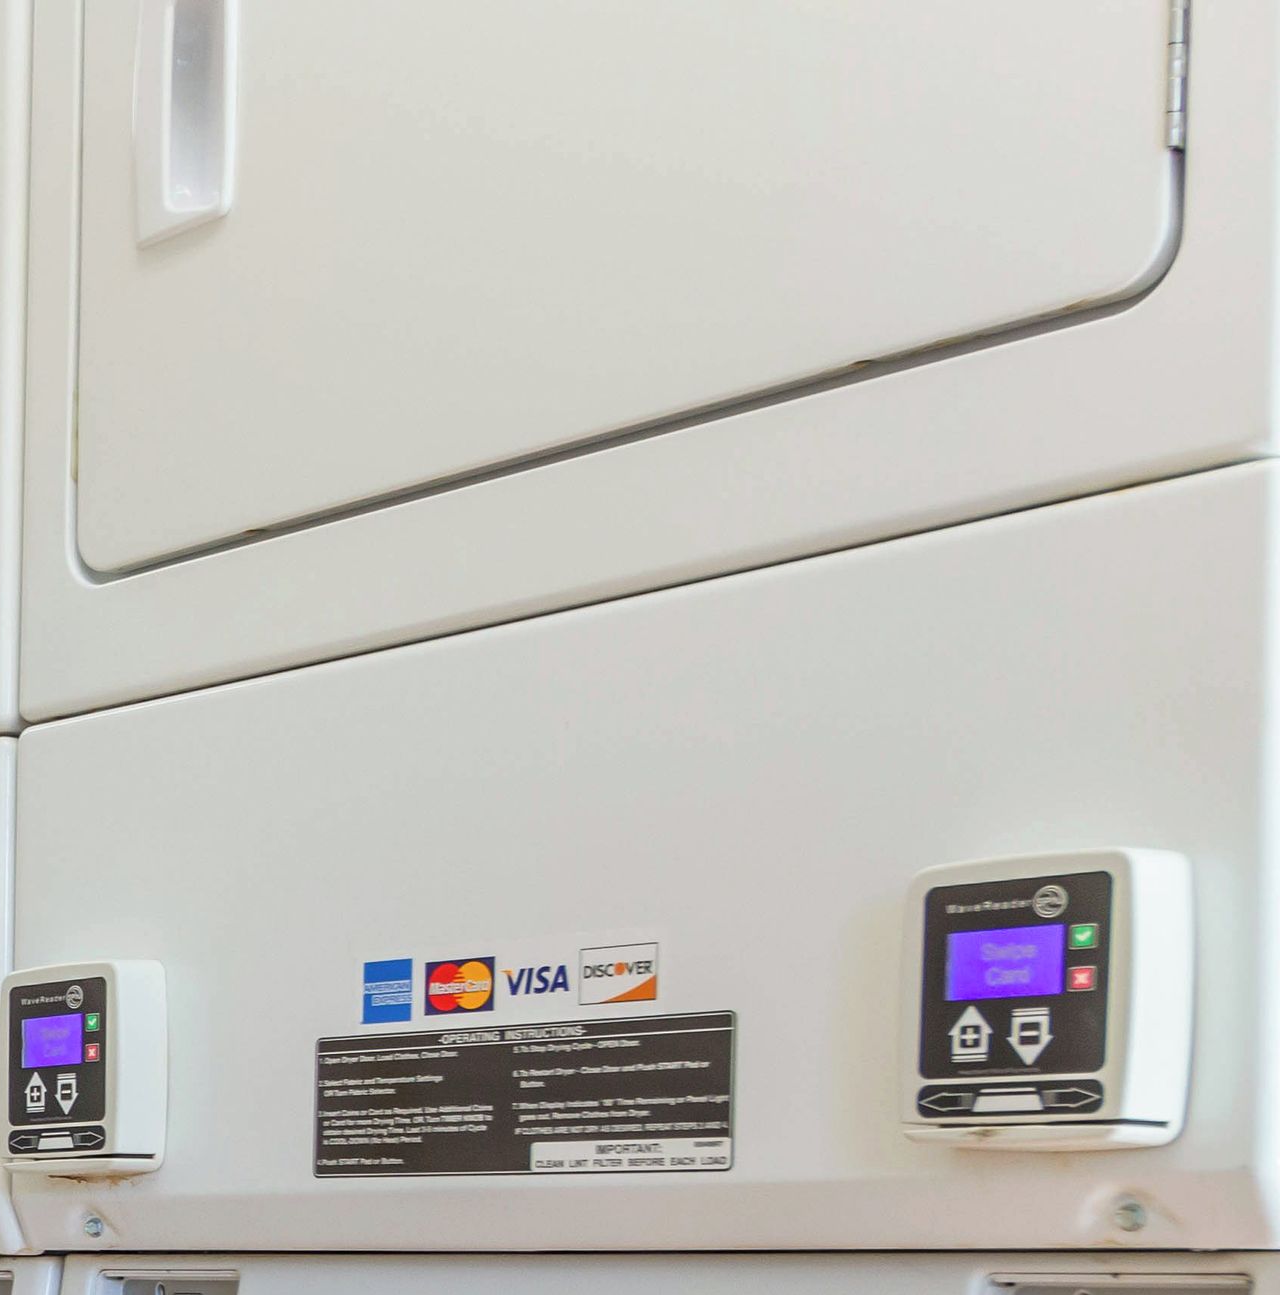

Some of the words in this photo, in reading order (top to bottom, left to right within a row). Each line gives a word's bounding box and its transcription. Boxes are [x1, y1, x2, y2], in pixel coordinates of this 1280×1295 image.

[583, 959, 654, 980] DISCOVER
[364, 980, 412, 994] AMERICAN
[429, 980, 490, 996] MasterCard
[500, 965, 570, 996] VISA
[535, 1159, 564, 1169] CLEAN
[569, 1159, 588, 1169] LINT
[593, 1158, 622, 1168] FILTER
[628, 1157, 665, 1167] BEFORE
[670, 1156, 696, 1166] EACH
[700, 1155, 727, 1166] LOAD
